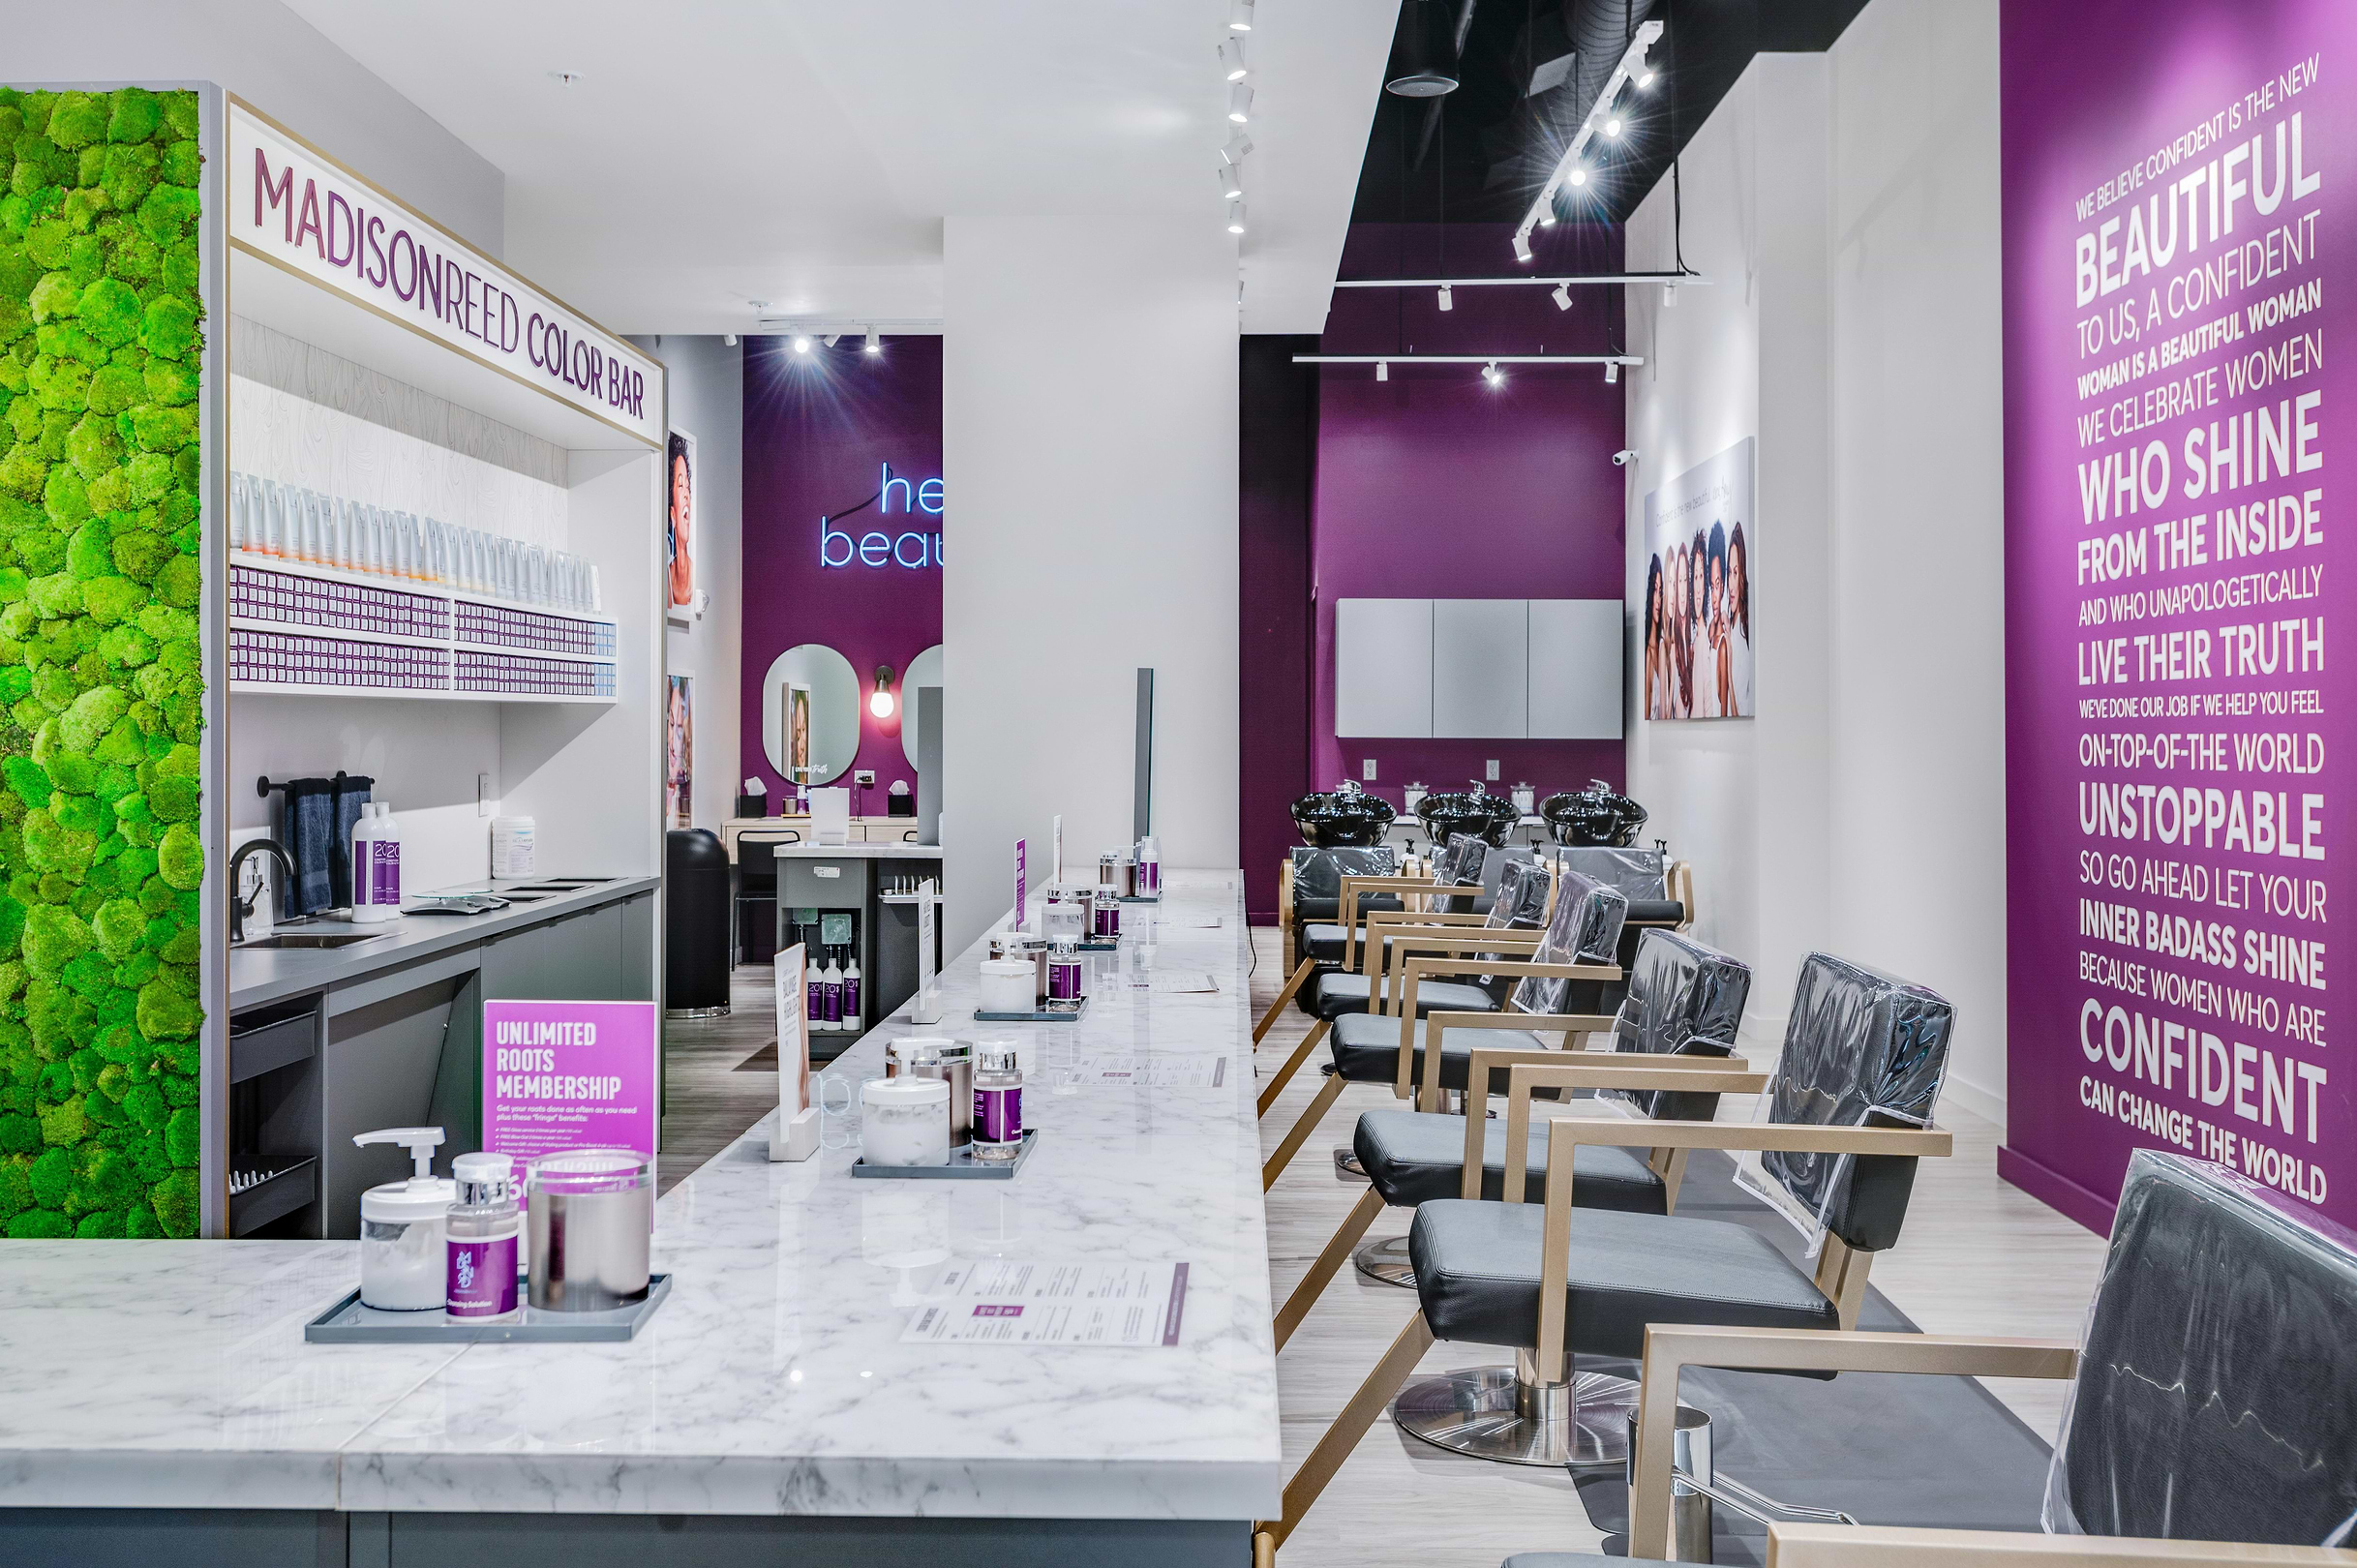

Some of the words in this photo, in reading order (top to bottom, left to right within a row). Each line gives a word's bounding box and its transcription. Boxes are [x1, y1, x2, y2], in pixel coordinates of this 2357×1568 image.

[2075, 192, 2095, 223] WE
[2097, 162, 2144, 212] BELIEVE
[2146, 110, 2224, 180] CONFIDENT
[2228, 102, 2241, 133] IS
[2244, 79, 2275, 121] THE
[2280, 52, 2319, 102] NEW
[2075, 110, 2320, 309] BEAUTIFUL
[2076, 316, 2103, 359] TO
[2109, 298, 2140, 343] US,
[2146, 287, 2161, 331] A
[2167, 208, 2320, 318] CONFIDENT
[527, 313, 603, 400] COLOR
[608, 356, 645, 420] BAR
[2077, 357, 2130, 401] WOMAN
[2132, 351, 2145, 379] IS
[2147, 347, 2159, 375] A
[2161, 312, 2244, 369] BEAUTIFUL
[2247, 277, 2321, 334] WOMAN
[2077, 408, 2105, 448] WE
[2109, 366, 2219, 437] CELEBRATE
[2224, 328, 2322, 399] WOMEN
[2077, 439, 2171, 526] WHO
[2183, 389, 2323, 499] SHINE
[821, 515, 944, 568] bea
[2077, 528, 2147, 586] FROM
[2153, 513, 2208, 572] THE
[2216, 488, 2323, 561] INSIDE
[2078, 597, 2106, 627] AND
[2110, 591, 2146, 622] WHO
[2149, 563, 2323, 618] UNAPOLOGETICALLY
[2078, 637, 2129, 685] LIVE
[2133, 629, 2212, 682] THEIR
[2219, 616, 2324, 678] TRUTH
[2079, 698, 2108, 719] WE'VE
[2109, 697, 2138, 718] DONE
[2140, 696, 2164, 717] OUR
[2165, 695, 2188, 717] JOB
[2191, 694, 2201, 716] IF
[2203, 693, 2223, 716] WE
[2225, 692, 2257, 715] HELP
[2259, 690, 2288, 714] YOU
[2291, 689, 2324, 714] FEEL
[2079, 733, 2228, 771] ON-TOP-OF-THE
[2233, 732, 2325, 774] WORLD
[2079, 781, 2325, 860] UNSTOPPABLE
[2079, 849, 2103, 885] SO
[2107, 854, 2136, 890] GO
[2141, 858, 2209, 903] AHEAD
[2215, 867, 2253, 911] LET
[2258, 872, 2327, 923] YOUR
[2079, 897, 2140, 949] INNER
[2145, 909, 2237, 970] BADASS
[2243, 929, 2327, 990] SHINE
[496, 1021, 596, 1046] UNLIMITED
[2079, 950, 2147, 998] BECAUSE
[2150, 968, 2222, 1018] WOMEN
[2226, 986, 2280, 1033] WHO
[2284, 1002, 2327, 1048] ARE
[496, 1048, 555, 1072] ROOTS
[496, 1075, 622, 1101] MEMBERSHIP
[2080, 997, 2327, 1144] CONFIDENT
[2079, 1074, 2114, 1118] CAN
[2117, 1089, 2193, 1151] CHANGE
[2197, 1119, 2237, 1169] THE
[2241, 1136, 2327, 1205] WORLD
